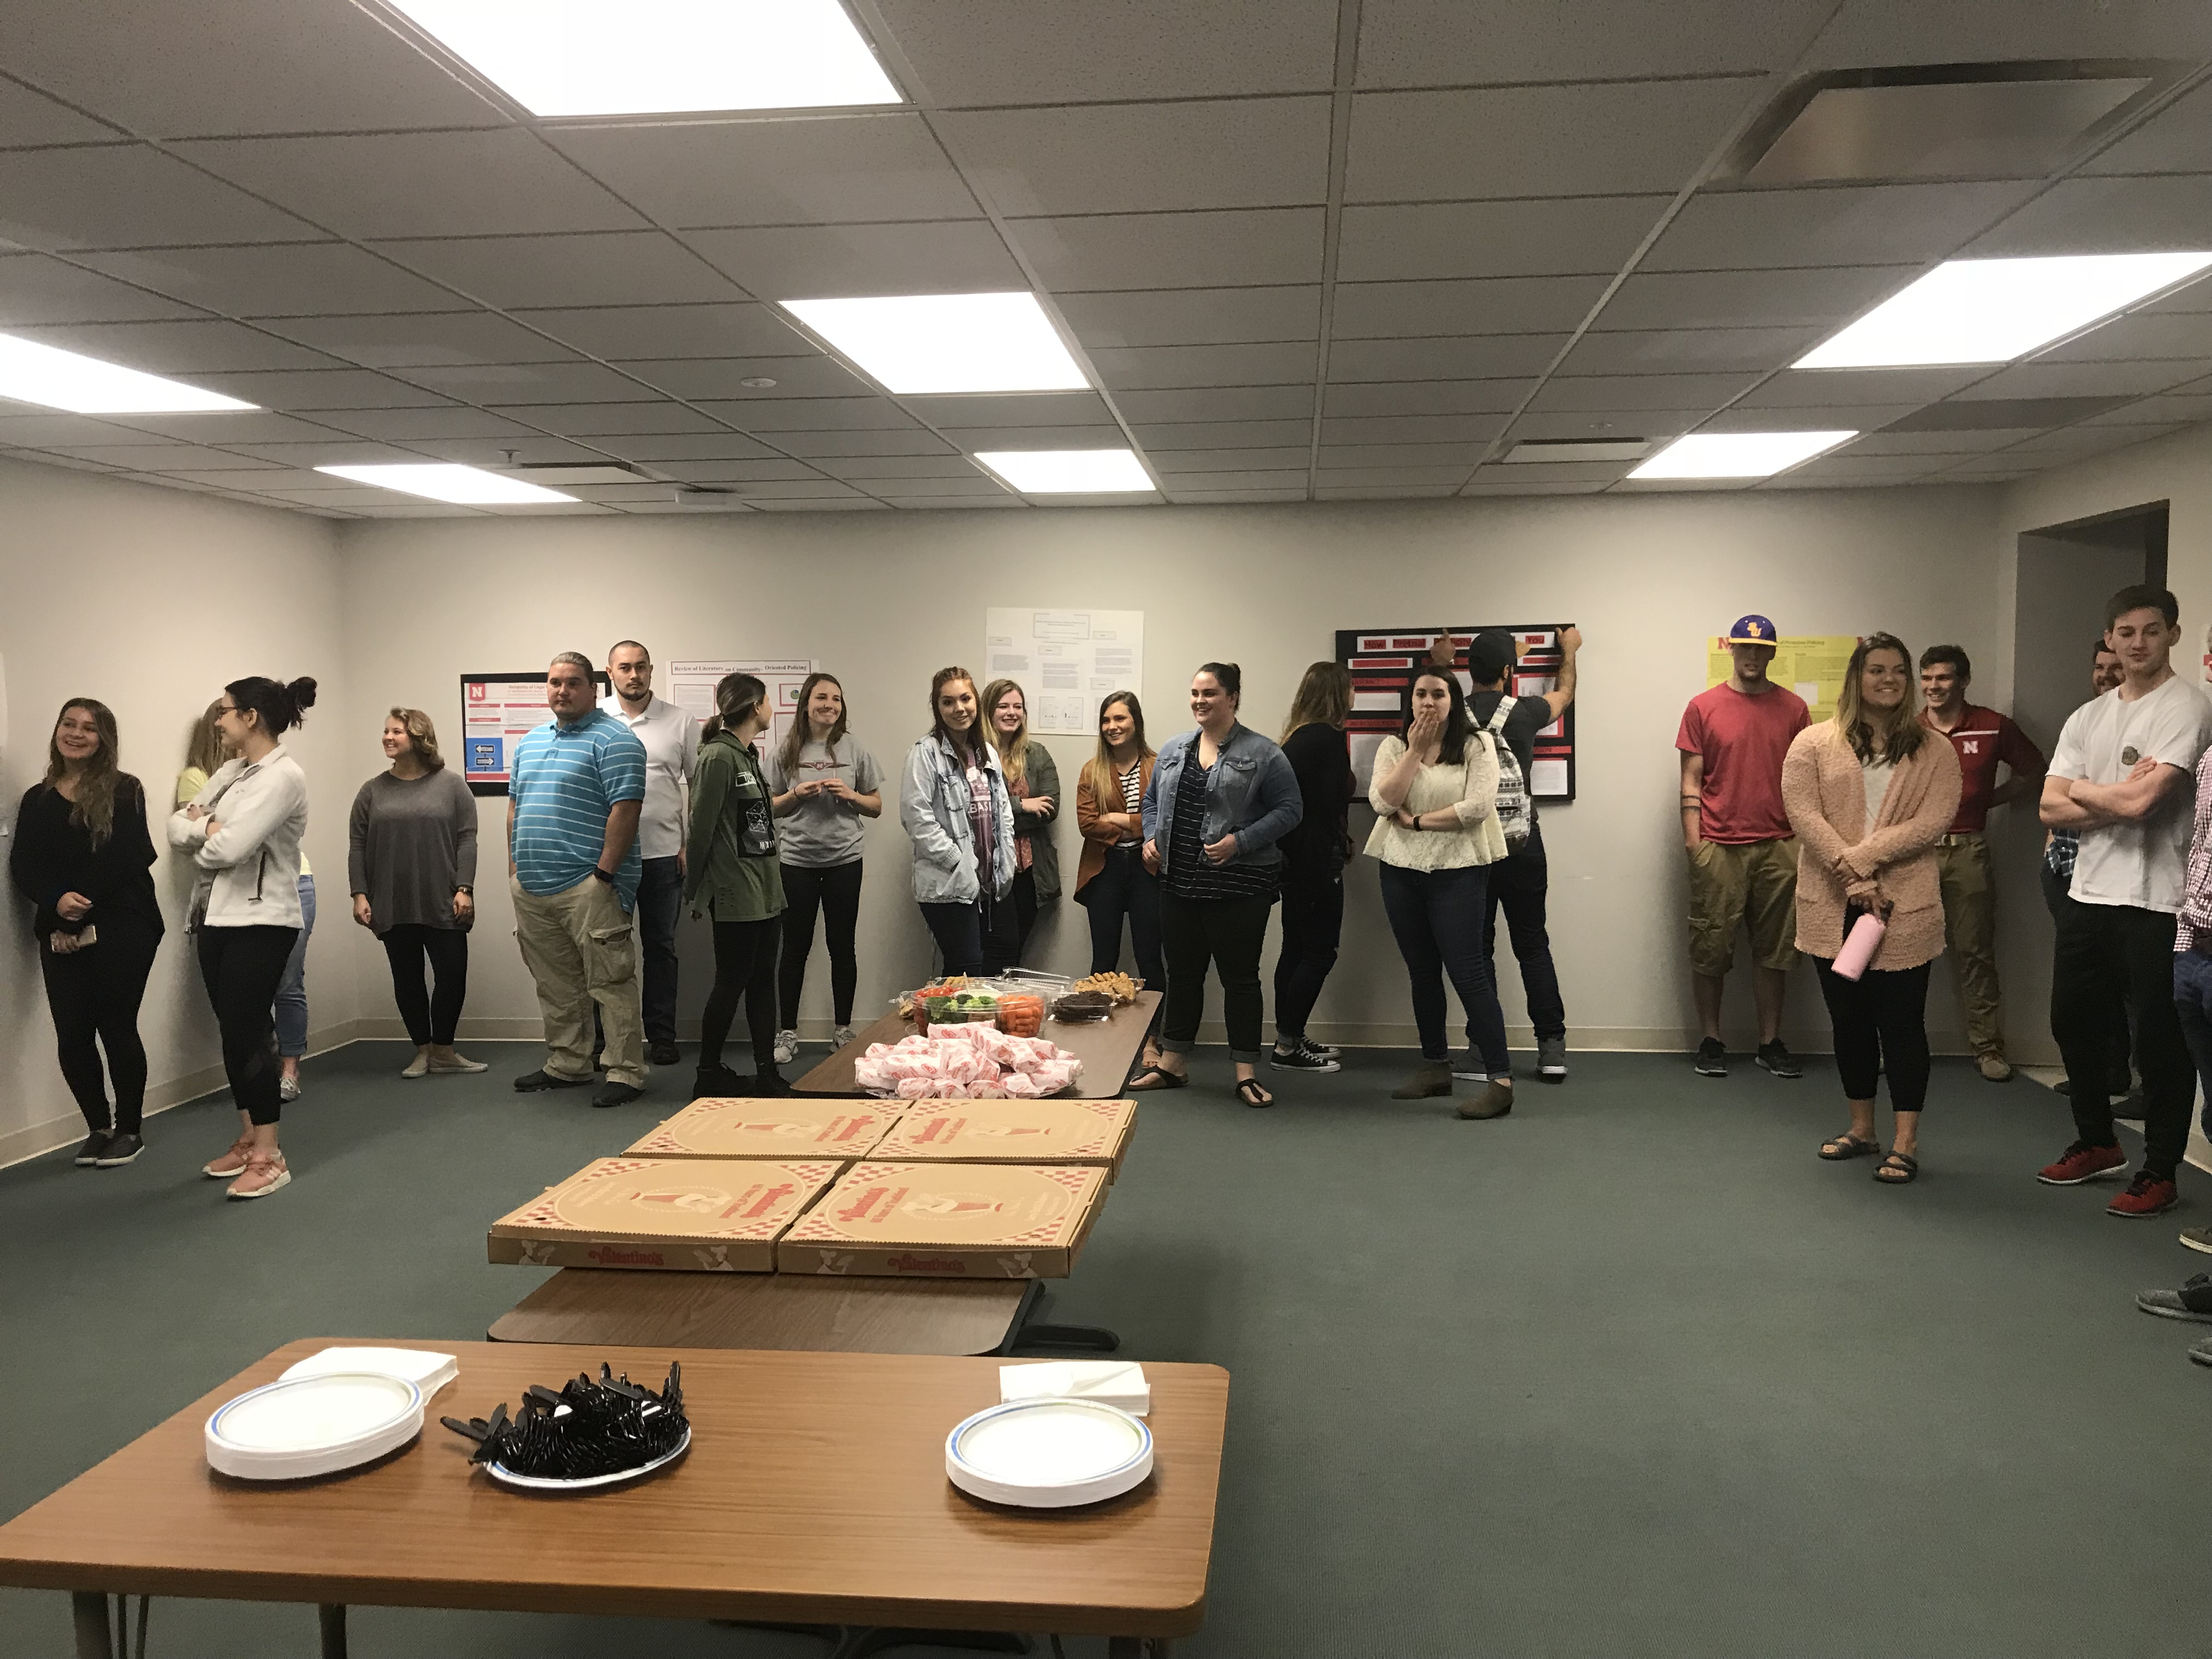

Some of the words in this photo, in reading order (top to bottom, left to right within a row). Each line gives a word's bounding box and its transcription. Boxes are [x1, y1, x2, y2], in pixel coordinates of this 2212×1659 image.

[1527, 636, 1544, 644] You
[472, 687, 483, 697] N
[1962, 741, 1978, 754] N
